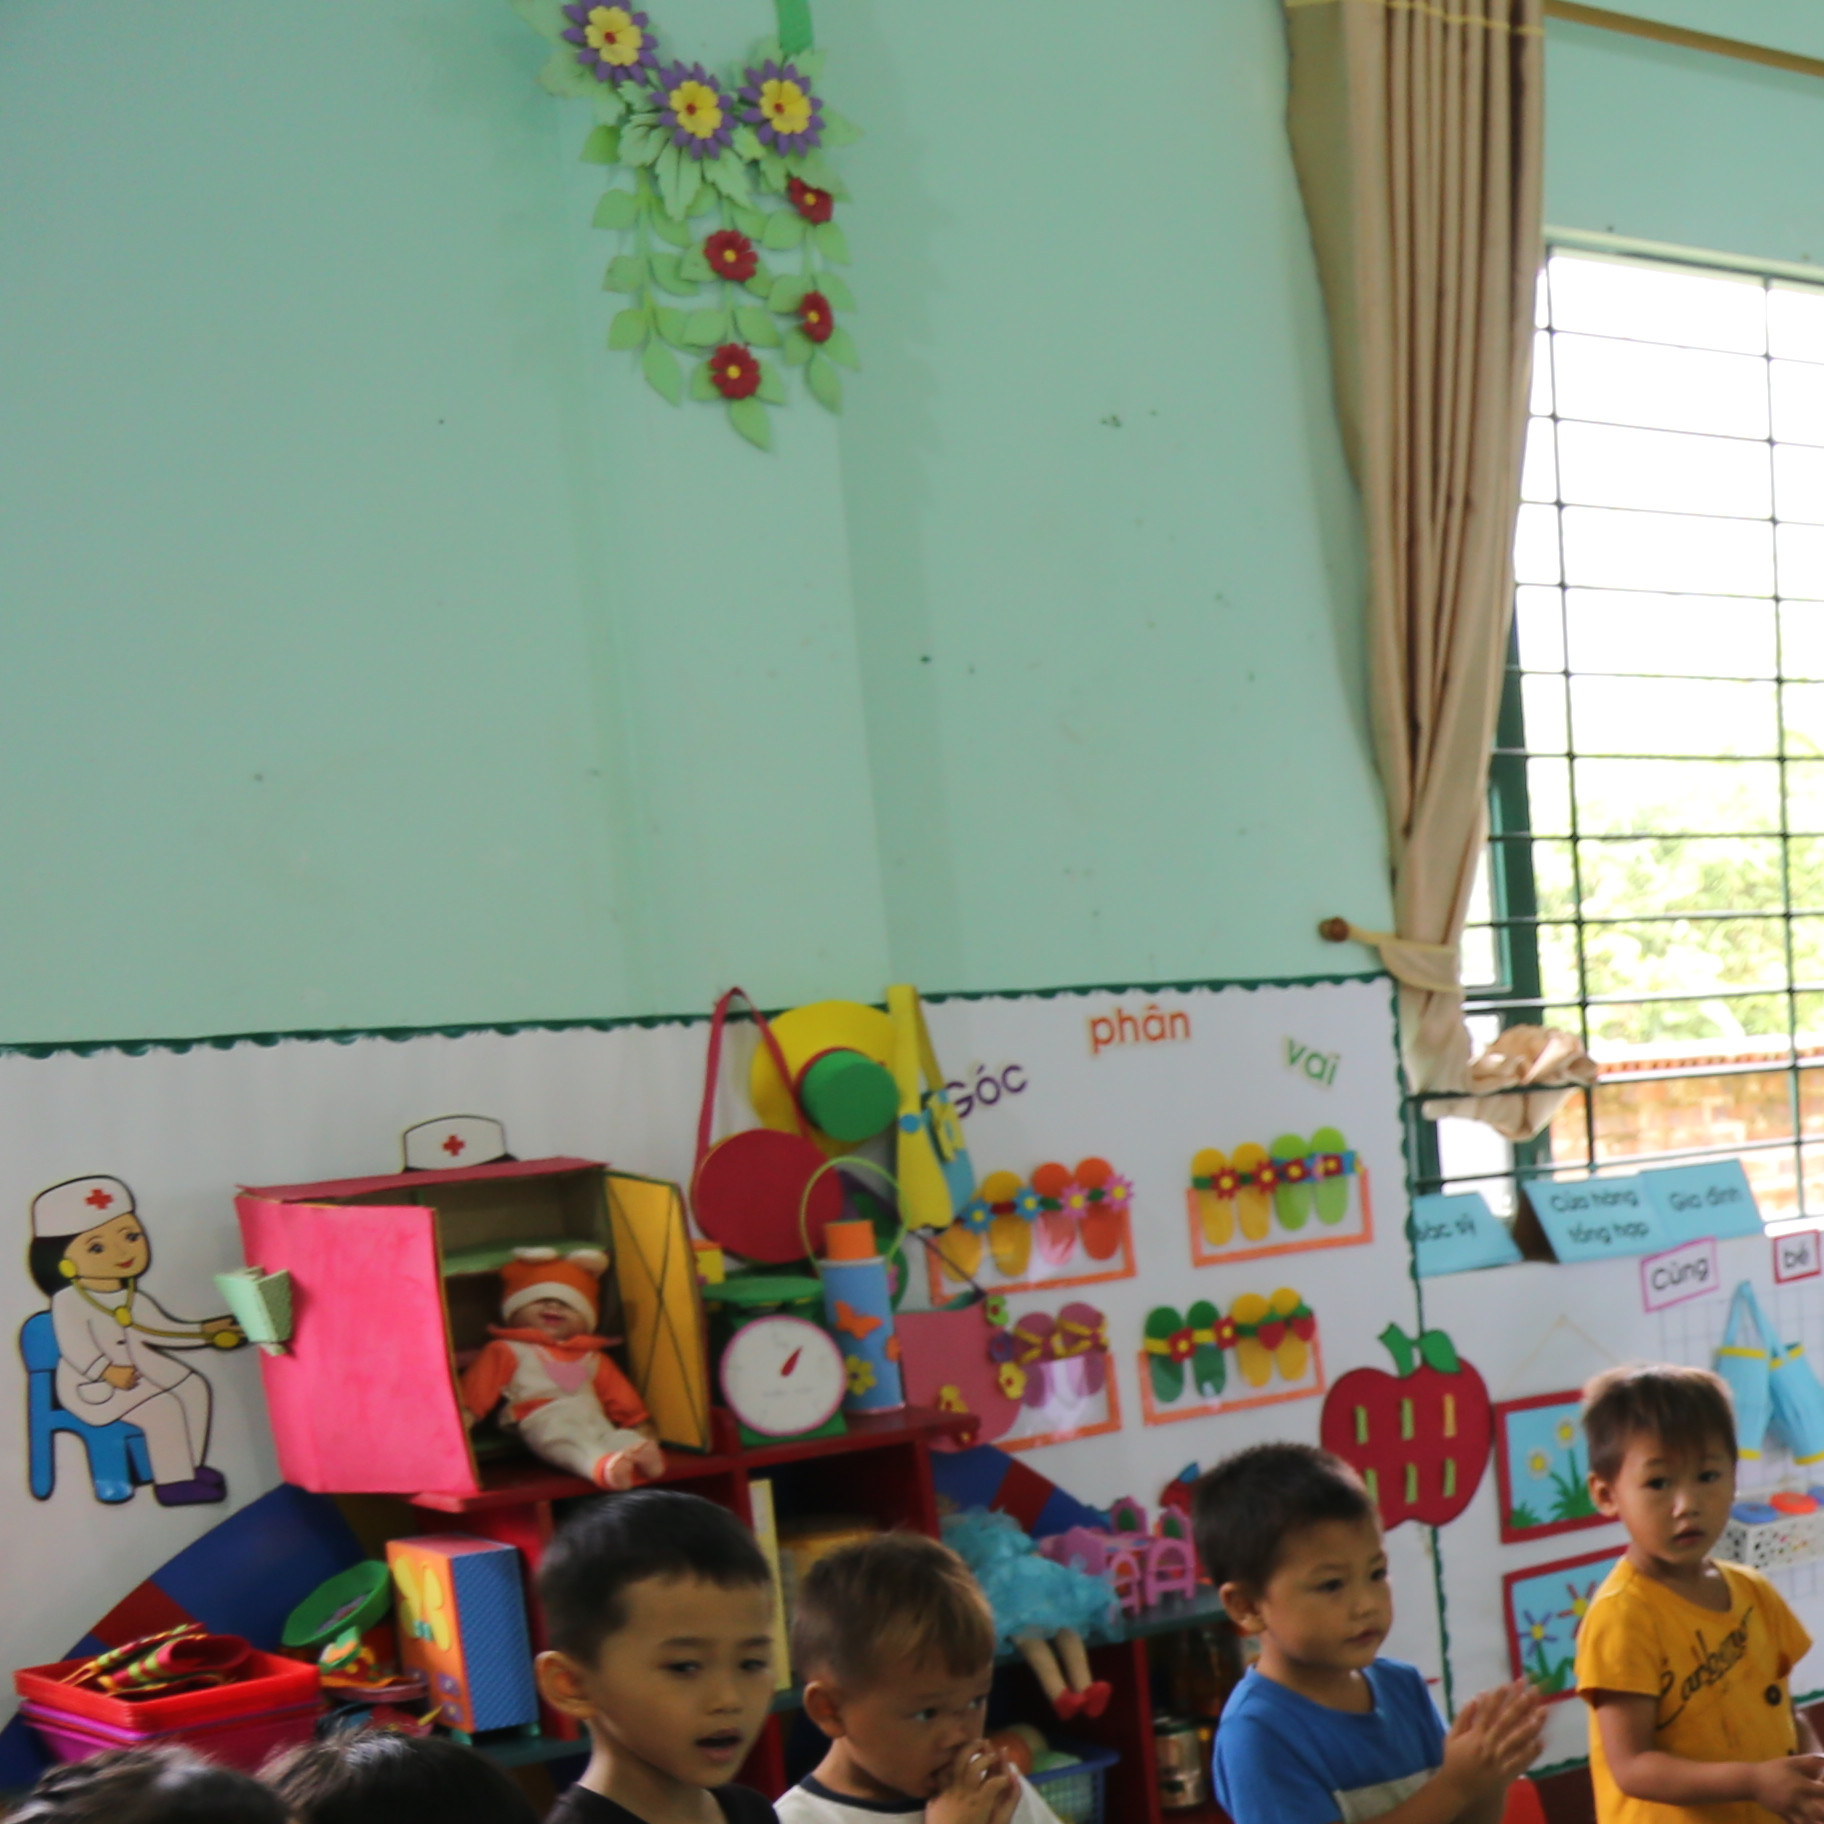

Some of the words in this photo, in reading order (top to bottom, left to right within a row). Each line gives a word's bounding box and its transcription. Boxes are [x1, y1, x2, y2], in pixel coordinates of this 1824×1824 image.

[1089, 1004, 1191, 1054] phân
[1285, 1037, 1341, 1086] vai
[1651, 1256, 1710, 1292] Cùng
[1784, 1244, 1808, 1269] bé
